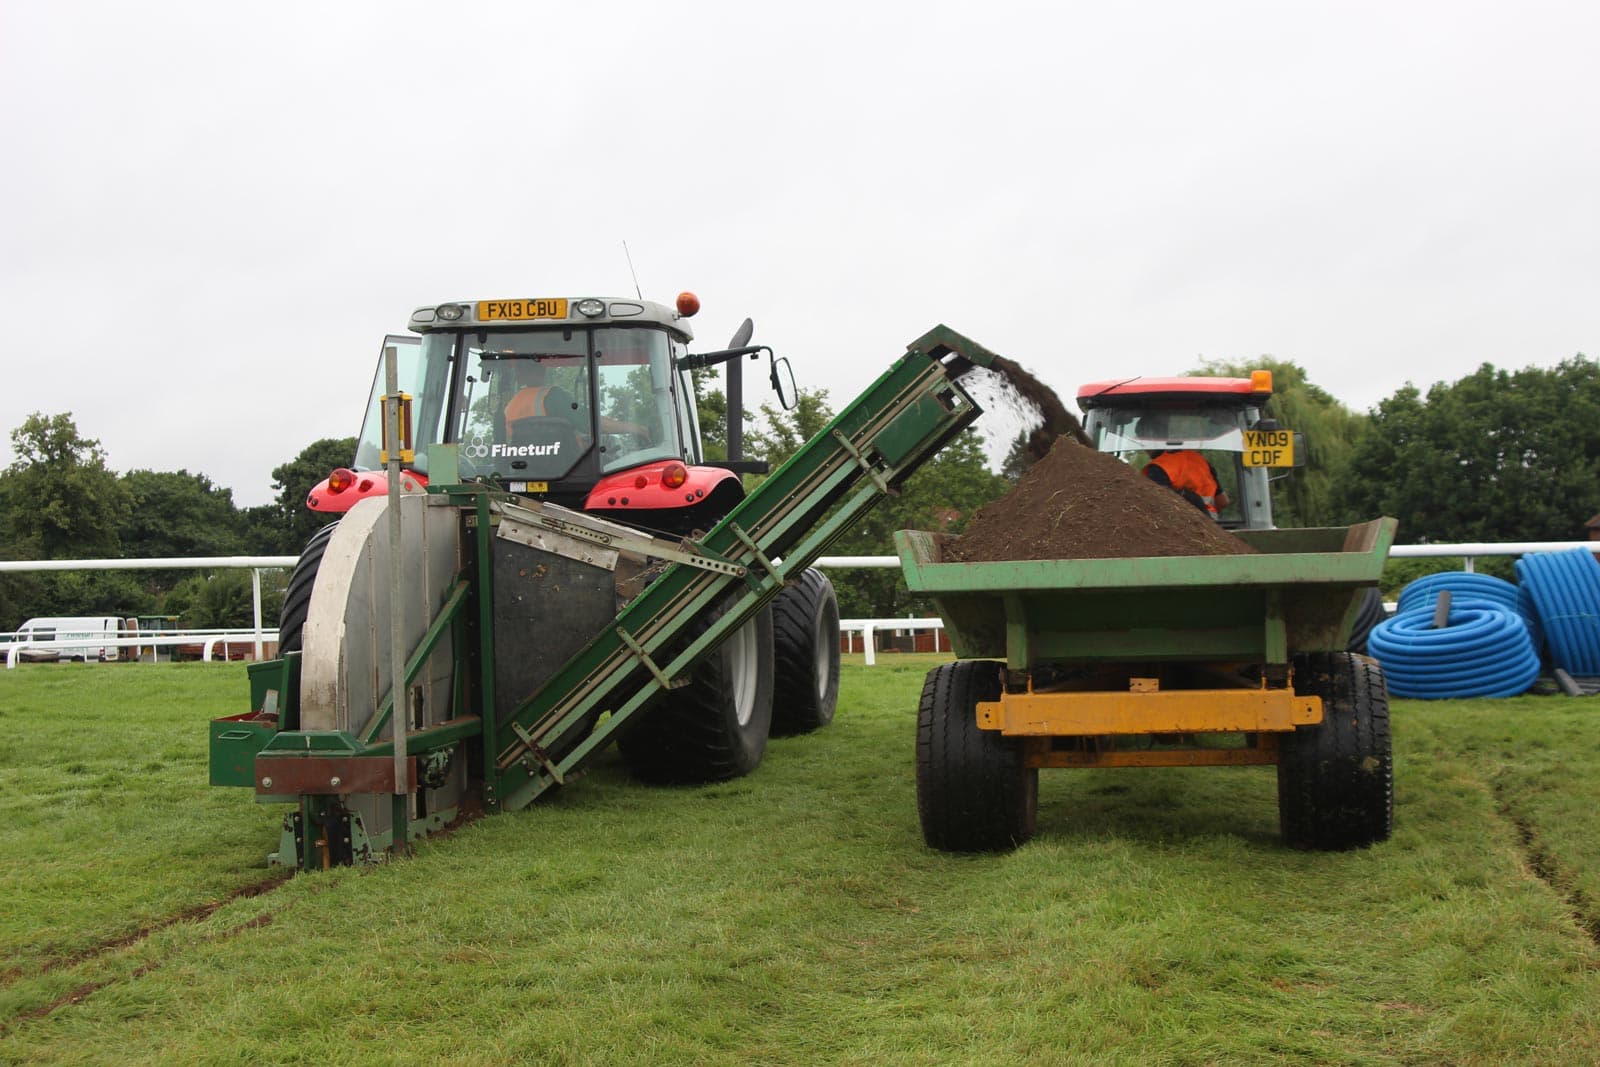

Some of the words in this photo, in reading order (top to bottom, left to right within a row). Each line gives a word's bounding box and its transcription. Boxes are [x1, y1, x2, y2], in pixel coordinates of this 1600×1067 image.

[487, 302, 522, 318] FX13
[526, 300, 557, 317] CBU
[1246, 432, 1289, 447] YN09
[491, 441, 560, 457] Fineturf
[1251, 450, 1282, 465] CDF
